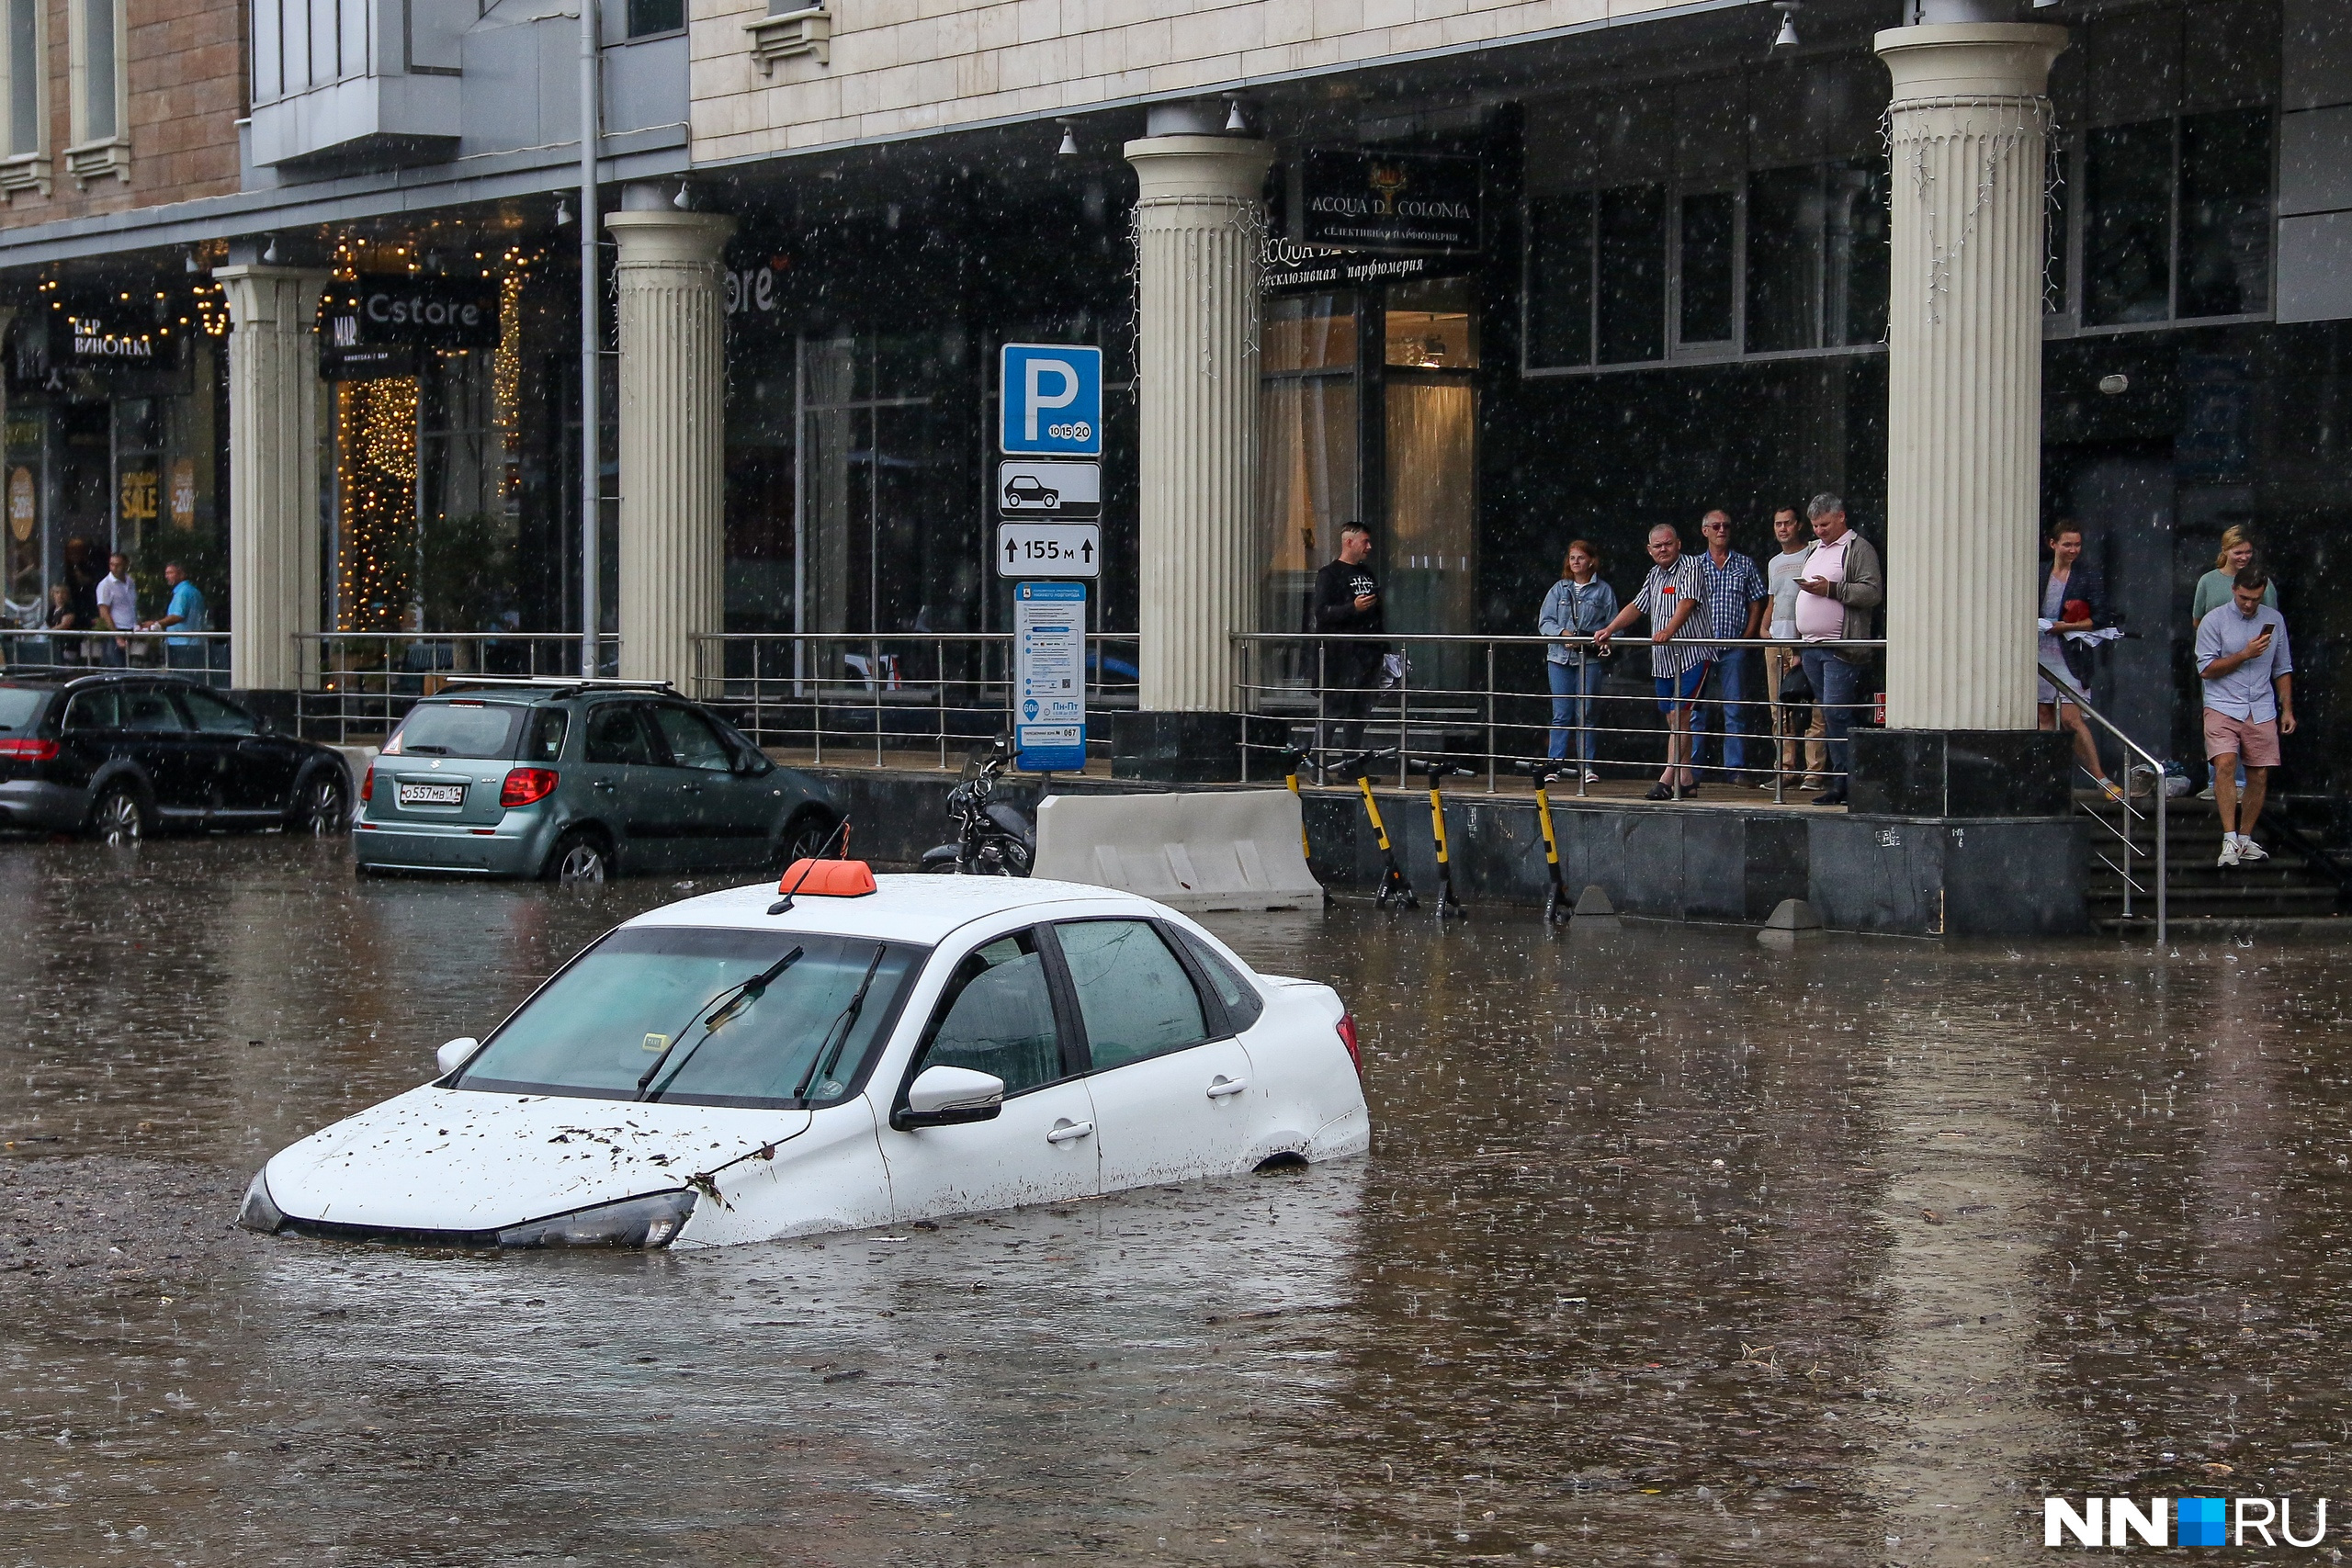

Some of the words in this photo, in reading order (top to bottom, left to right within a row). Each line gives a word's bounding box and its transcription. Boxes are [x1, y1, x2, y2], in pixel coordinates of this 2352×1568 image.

[1312, 197, 1367, 218] ACQUA
[1397, 200, 1470, 219] COLONIA
[1324, 227, 1390, 240] СЕЛЕКТИВНАЯ
[1393, 230, 1459, 242] ПАРФЮМЕРИЯ
[1347, 258, 1423, 281] парфюмерия
[367, 293, 480, 326] Cstore
[74, 318, 101, 335] БАР
[74, 336, 153, 356] ВИНОТЕКА
[1025, 358, 1080, 441] P
[1050, 427, 1060, 435] 10
[1062, 427, 1072, 435] 15
[1075, 426, 1090, 437] 20
[121, 488, 158, 519] SALE
[1023, 540, 1059, 559] 155
[1063, 728, 1077, 737] 067
